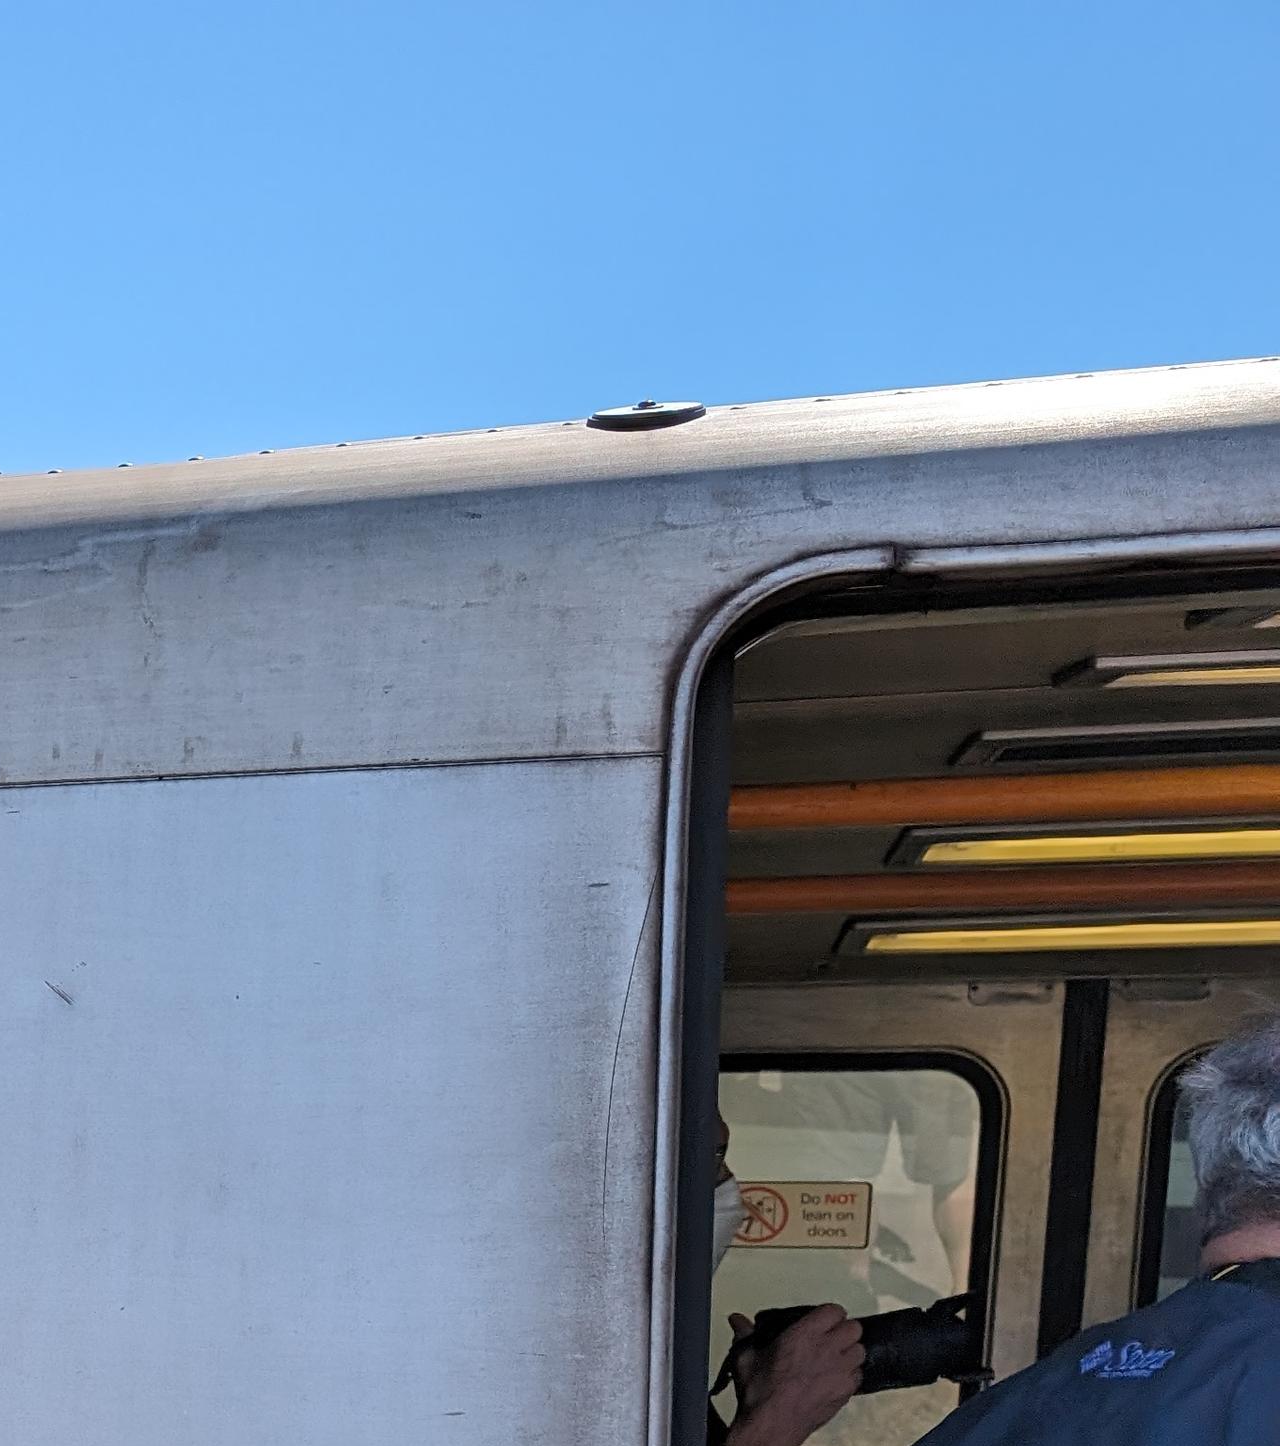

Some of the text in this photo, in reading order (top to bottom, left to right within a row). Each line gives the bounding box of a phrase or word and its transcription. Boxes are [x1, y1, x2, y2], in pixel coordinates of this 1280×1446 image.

[801, 1192, 856, 1205] Do NOT
[802, 1209, 854, 1221] lean on
